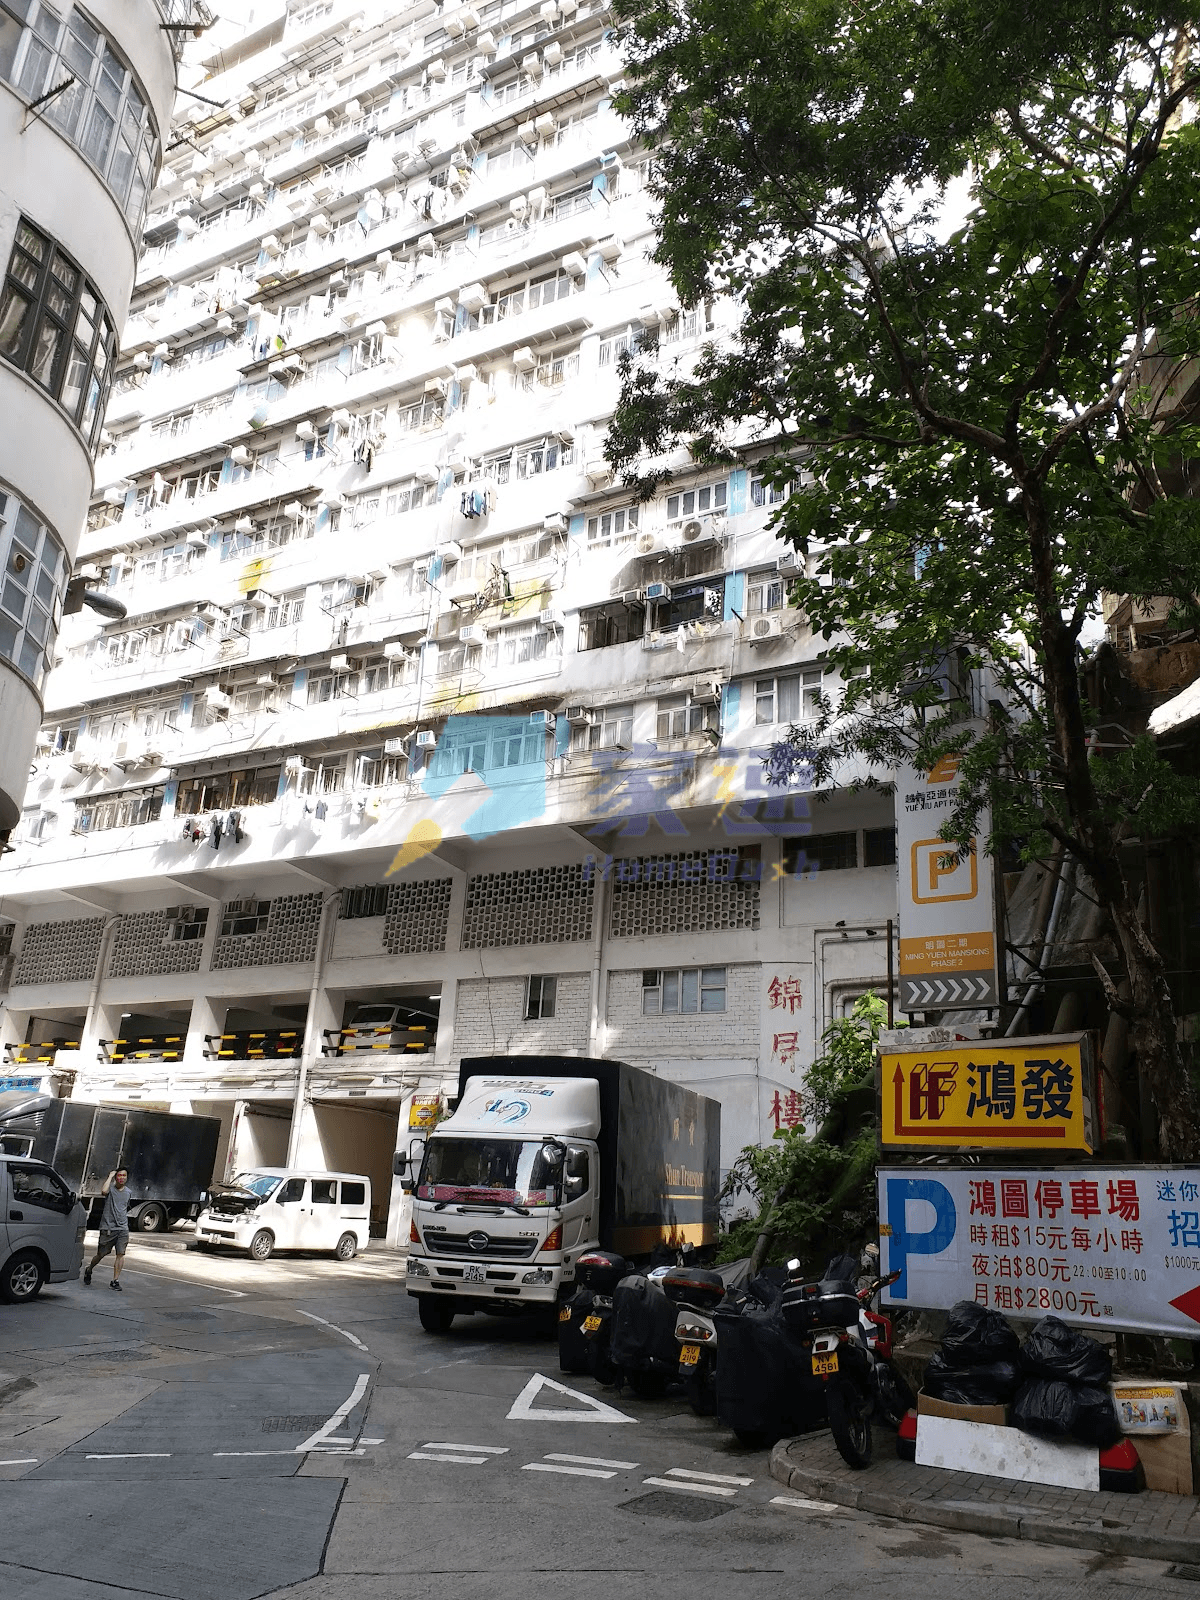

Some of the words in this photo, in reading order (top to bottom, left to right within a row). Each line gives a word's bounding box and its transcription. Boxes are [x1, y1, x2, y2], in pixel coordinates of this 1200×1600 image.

[934, 799, 947, 808] APT
[929, 850, 958, 890] P
[931, 959, 957, 967] PHASE
[958, 958, 963, 966] 2
[949, 948, 990, 957] MANSIONS
[966, 1058, 1075, 1120] 鴻發
[968, 1178, 1140, 1222] 鴻圖停車場
[886, 1178, 957, 1300] P
[969, 1223, 1144, 1255] 時租$15元每小時
[465, 1271, 484, 1281] 2145
[469, 1265, 481, 1273] RK
